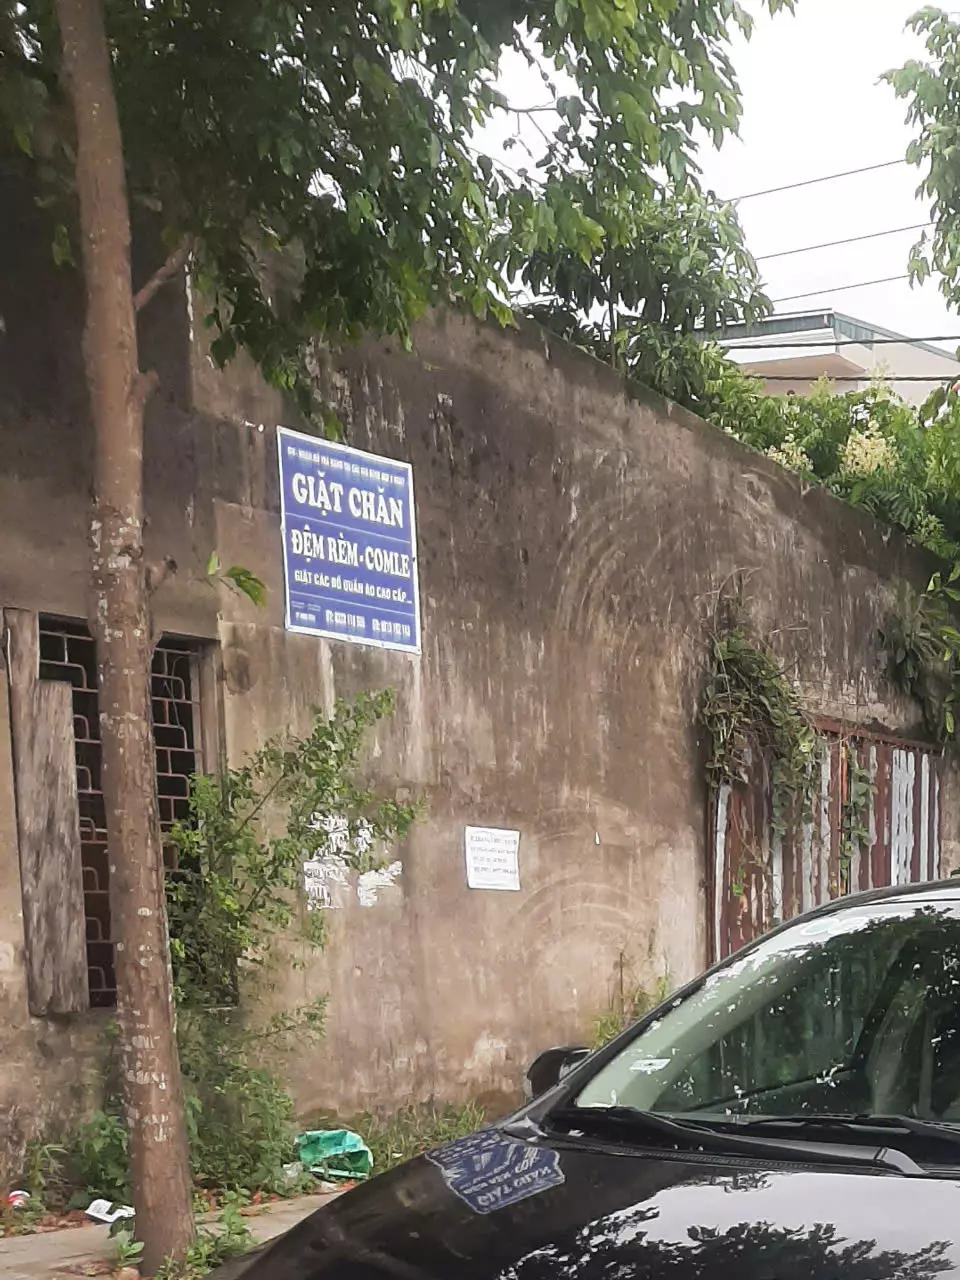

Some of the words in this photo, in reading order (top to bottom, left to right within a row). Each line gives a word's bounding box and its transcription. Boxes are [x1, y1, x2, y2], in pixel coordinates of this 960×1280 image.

[292, 469, 344, 517] GIẶT
[348, 485, 404, 529] CHĂN
[291, 523, 325, 563] ĐỆM
